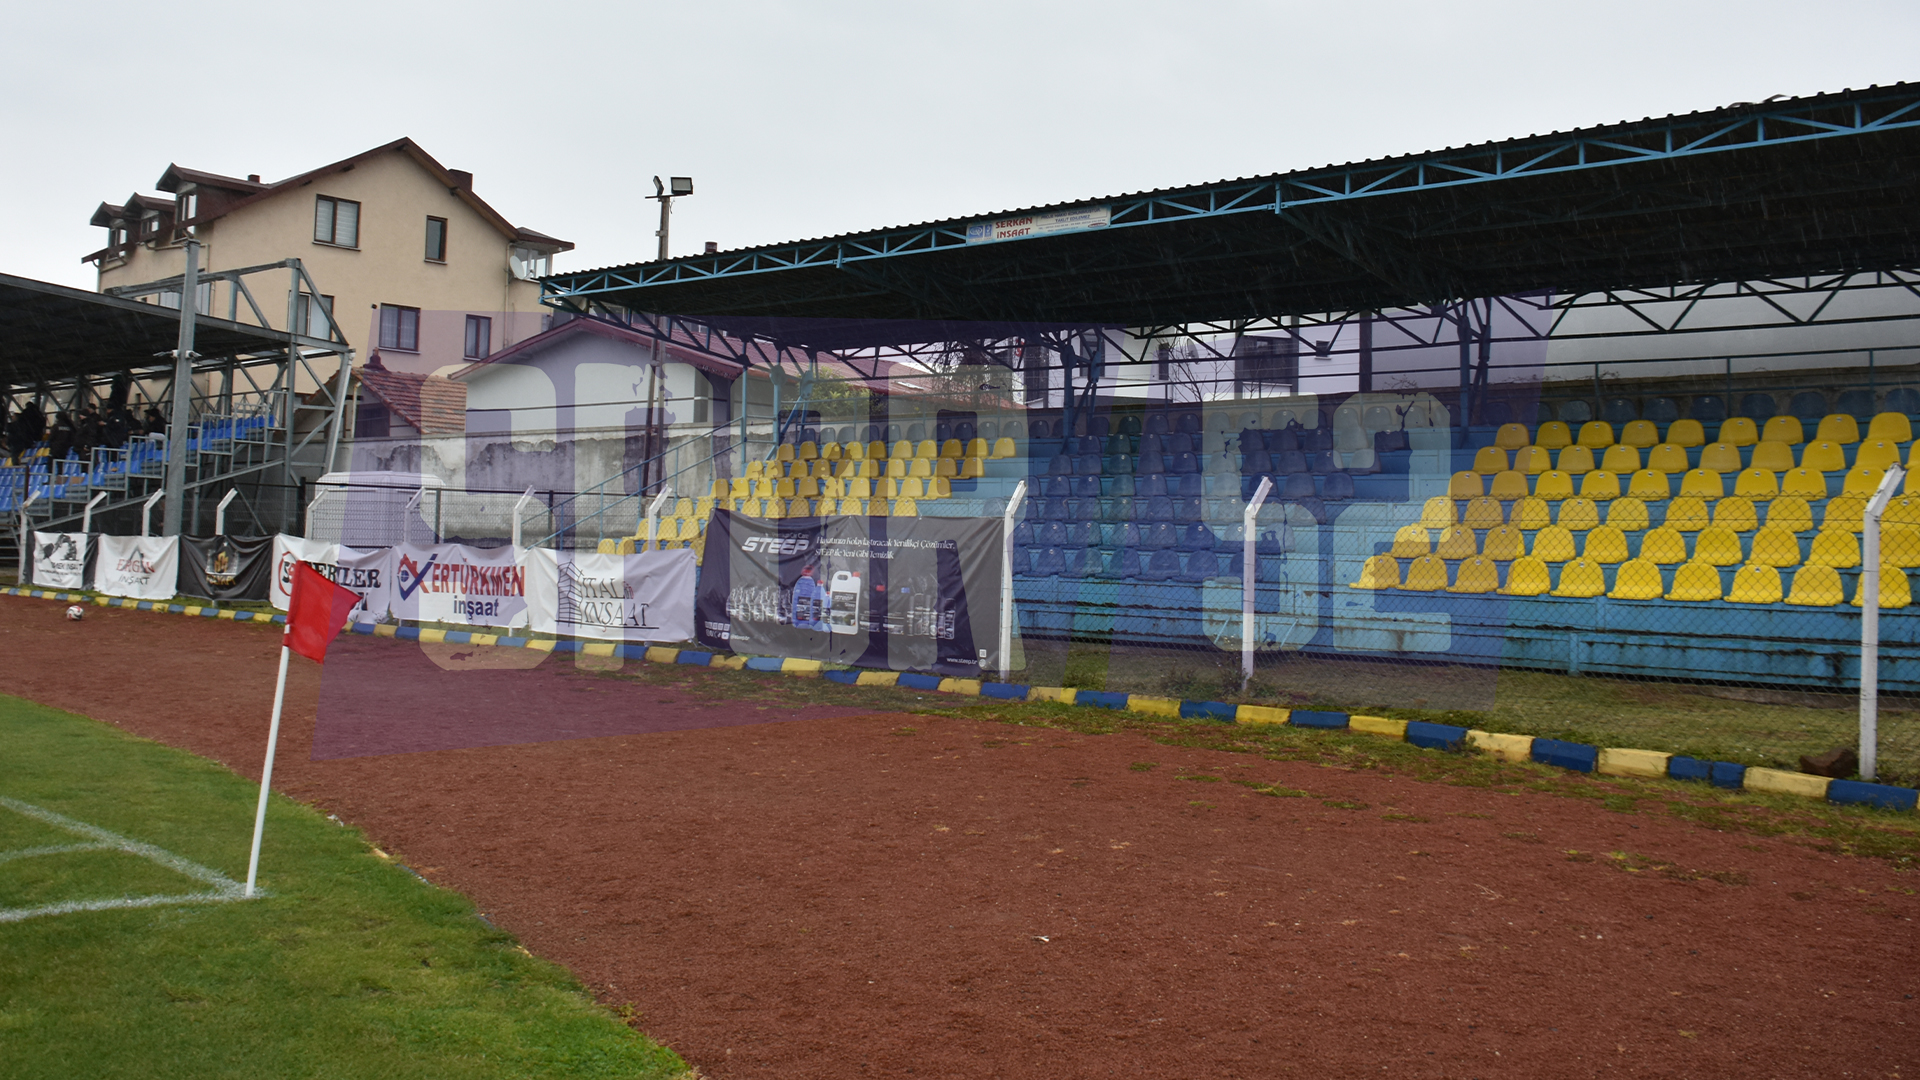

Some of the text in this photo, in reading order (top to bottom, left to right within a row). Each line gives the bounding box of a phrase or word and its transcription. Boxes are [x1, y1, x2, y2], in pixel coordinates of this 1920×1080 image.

[996, 217, 1033, 229] SERKAN
[741, 537, 810, 555] STEEP
[894, 539, 919, 549] Yenilikçi
[815, 549, 834, 557] STEEP
[843, 549, 856, 557] Yeni
[856, 549, 869, 558] Gibi
[870, 551, 894, 559] Temizlik
[432, 558, 525, 597] ERTÜRKMEN
[453, 595, 499, 620] inşaat
